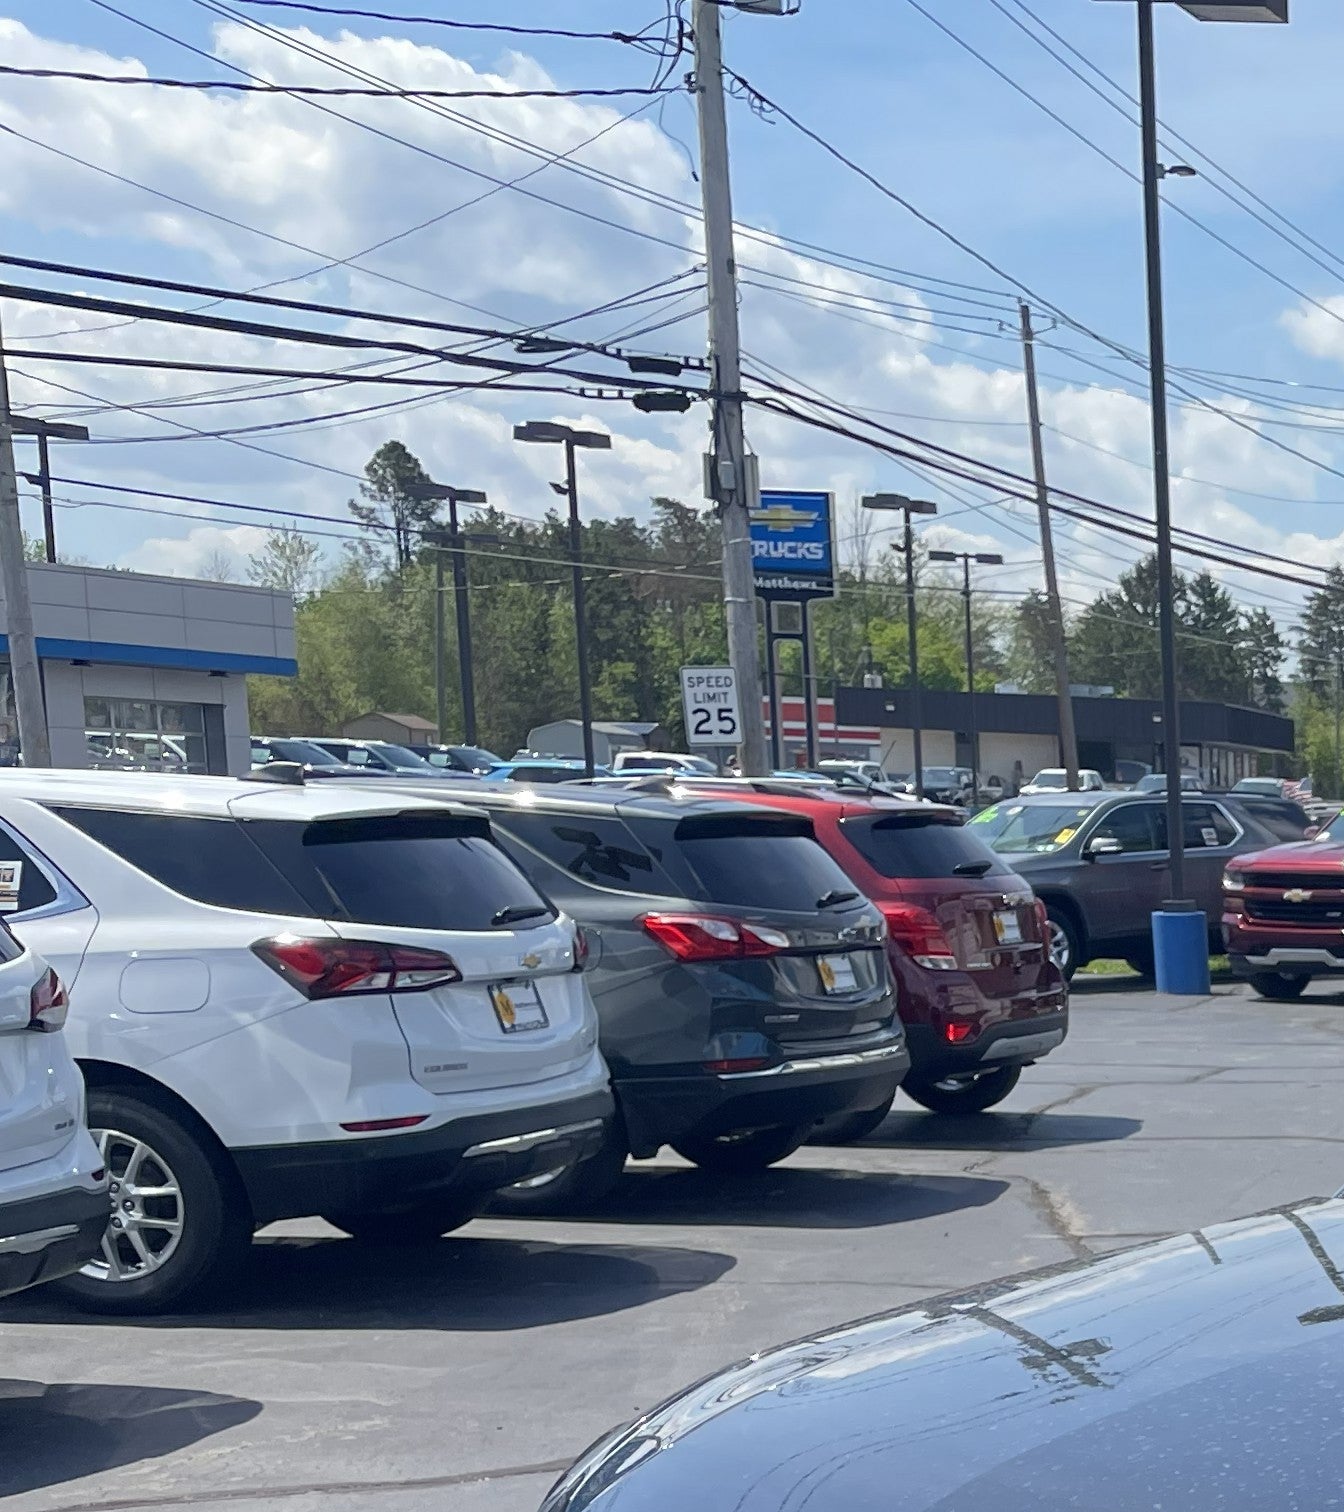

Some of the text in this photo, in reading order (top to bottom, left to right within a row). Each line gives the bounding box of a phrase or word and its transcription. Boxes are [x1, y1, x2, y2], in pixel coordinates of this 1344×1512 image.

[687, 675, 733, 688] SPEED
[693, 691, 729, 704] LIMIT
[692, 708, 736, 735] 25
